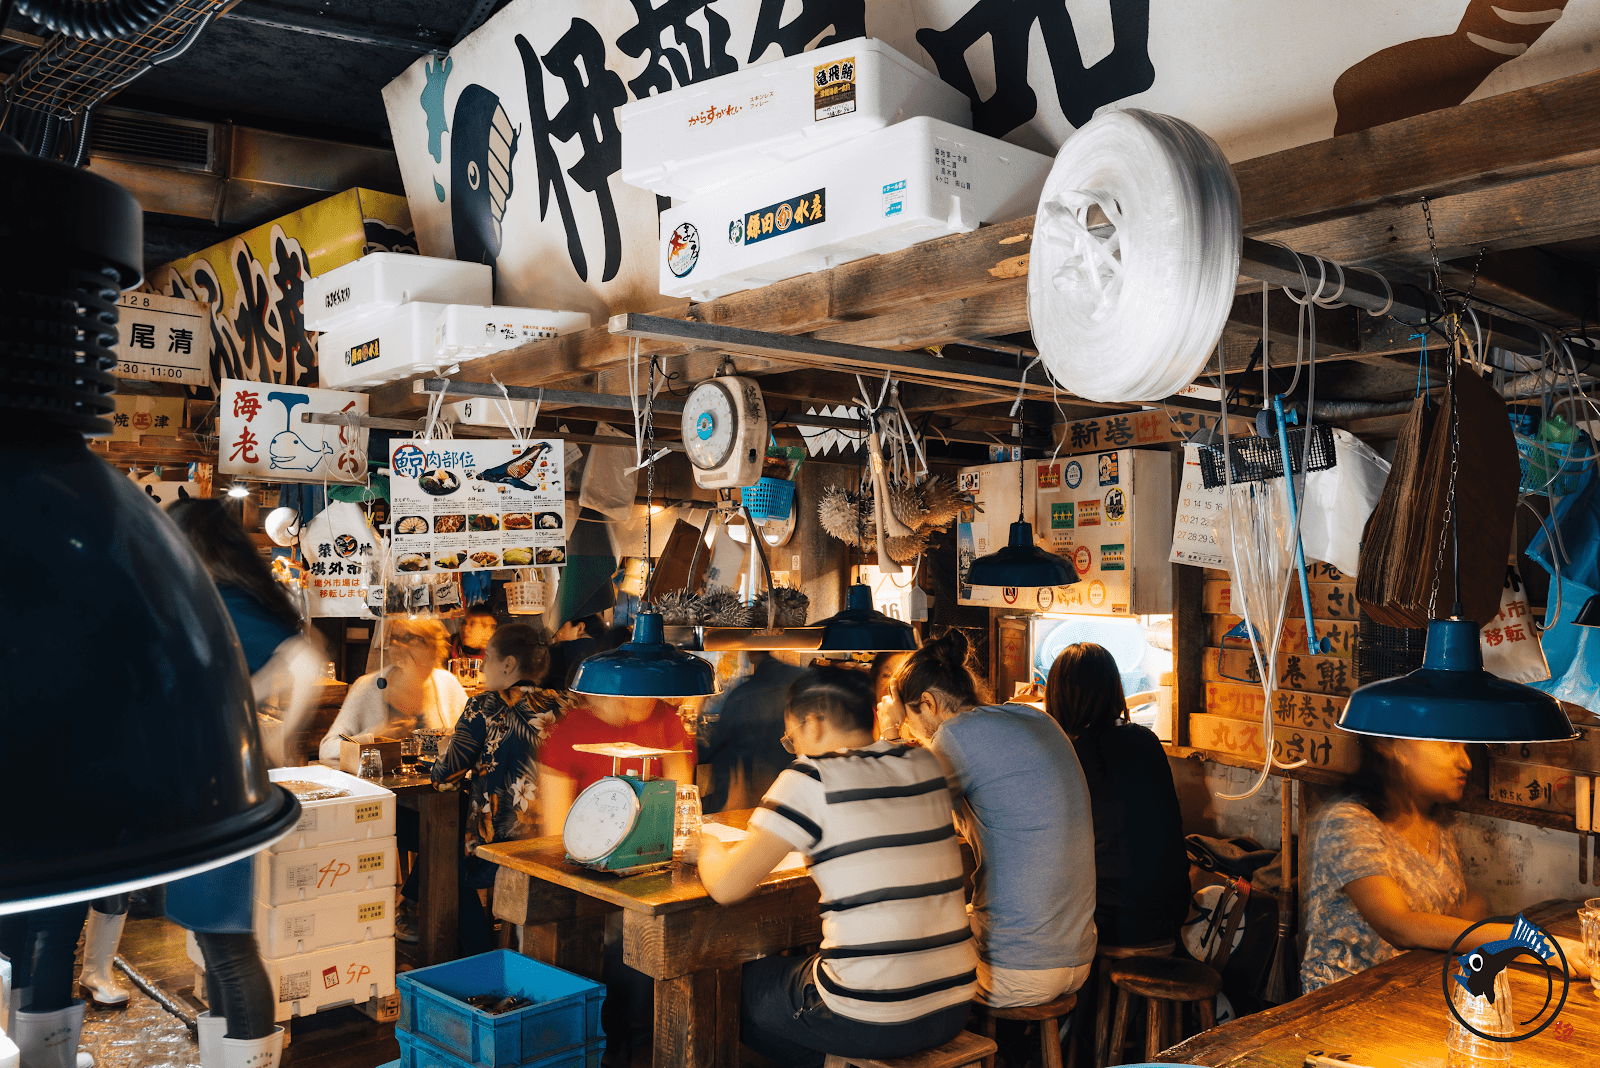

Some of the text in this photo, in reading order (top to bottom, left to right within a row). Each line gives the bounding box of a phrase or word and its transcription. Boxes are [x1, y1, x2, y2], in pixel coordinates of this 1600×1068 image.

[229, 390, 262, 464] 海老
[393, 446, 476, 479] 鯨肉部位
[1183, 498, 1191, 506] 13
[1194, 500, 1201, 508] 14
[1204, 501, 1212, 510] 15
[1179, 514, 1189, 523] 20
[1190, 516, 1199, 524] 21
[1177, 530, 1187, 539] 27
[1188, 532, 1197, 541] 28
[1198, 534, 1207, 543] 29
[314, 578, 360, 588] 場外市場は
